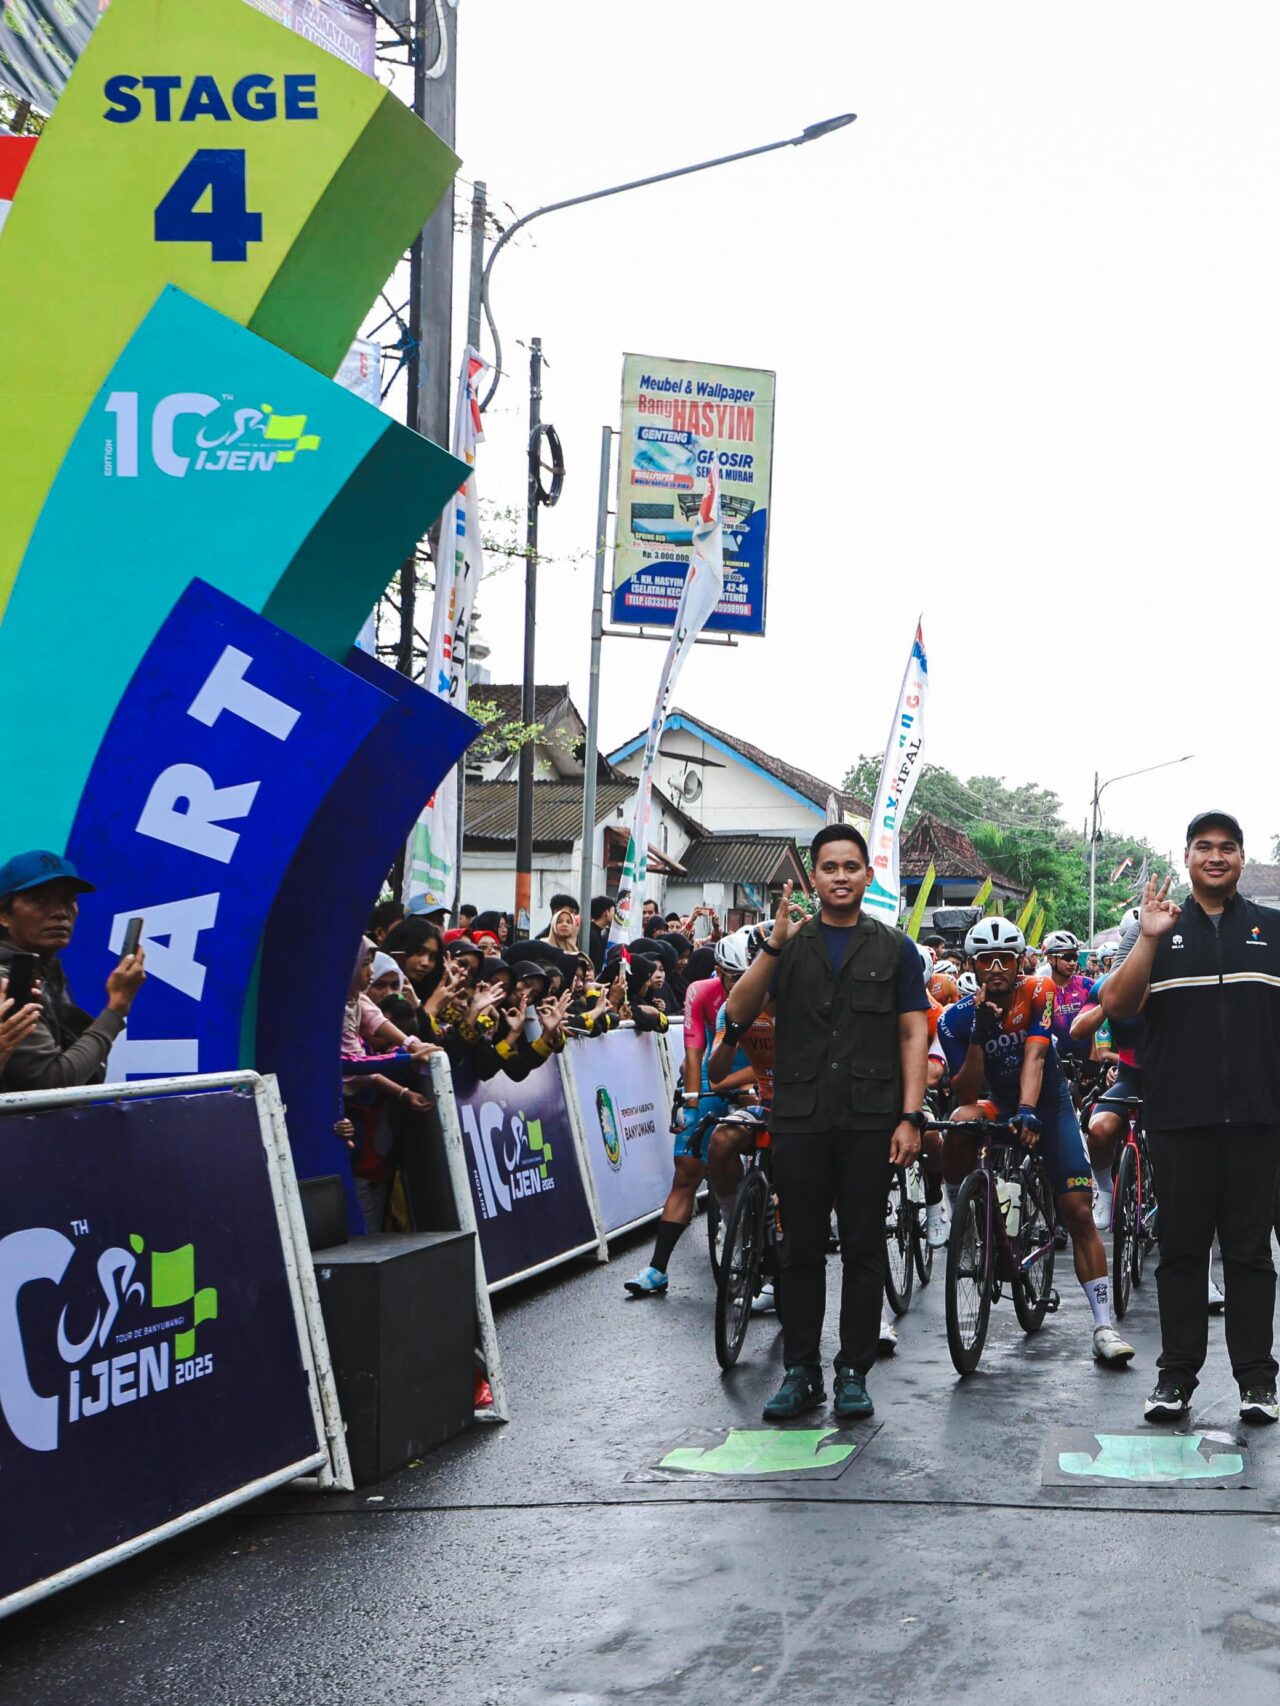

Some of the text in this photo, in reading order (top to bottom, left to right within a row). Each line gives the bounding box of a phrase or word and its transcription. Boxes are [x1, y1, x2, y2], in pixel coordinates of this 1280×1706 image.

[103, 74, 318, 122] STAGE
[154, 148, 262, 261] 4
[640, 374, 755, 403] Meubel & Wallpaper
[638, 394, 755, 443] Bang HASYIM
[641, 429, 688, 444] GENTENG
[104, 440, 113, 476] EDITION
[194, 450, 277, 472] IJEN
[725, 468, 754, 483] MURAH
[105, 645, 301, 1082] TART
[624, 1120, 656, 1141] BANYUWANGI
[510, 1167, 555, 1200] IJEN 2025
[70, 1219, 89, 1236] TH
[115, 1316, 185, 1344] TOUR DE BANYUWANGI
[69, 1341, 213, 1423] IJEN 2025
